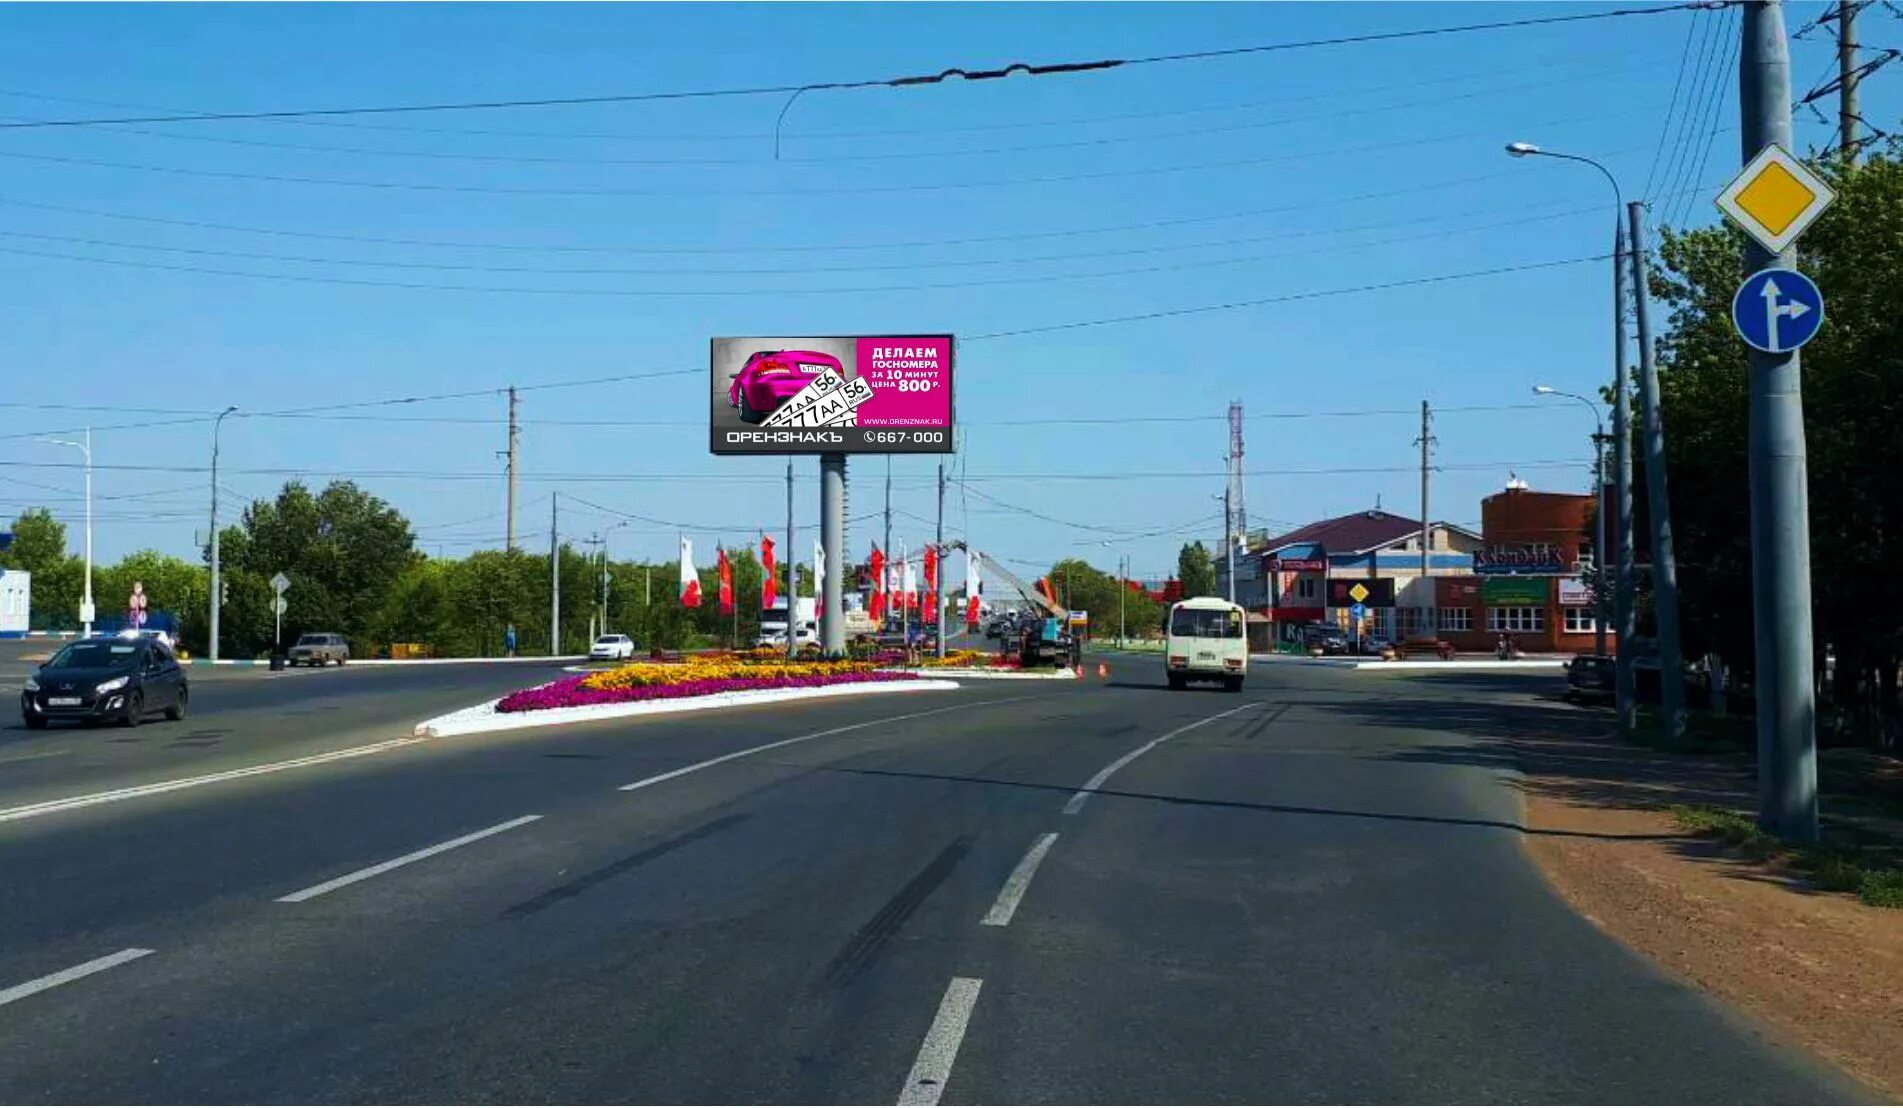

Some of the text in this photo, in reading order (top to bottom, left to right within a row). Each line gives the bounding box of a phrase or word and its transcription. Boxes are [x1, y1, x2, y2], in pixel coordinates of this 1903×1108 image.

[872, 347, 937, 360] ДЕЛАЕМ
[872, 360, 938, 369] ГОСНОМЕРА
[886, 370, 902, 380] 10
[815, 372, 836, 391] 56
[898, 379, 931, 392] 800
[843, 381, 865, 399] 56
[726, 431, 843, 443] ОРЕНЗНАКЪ
[877, 431, 943, 443] 667-000
